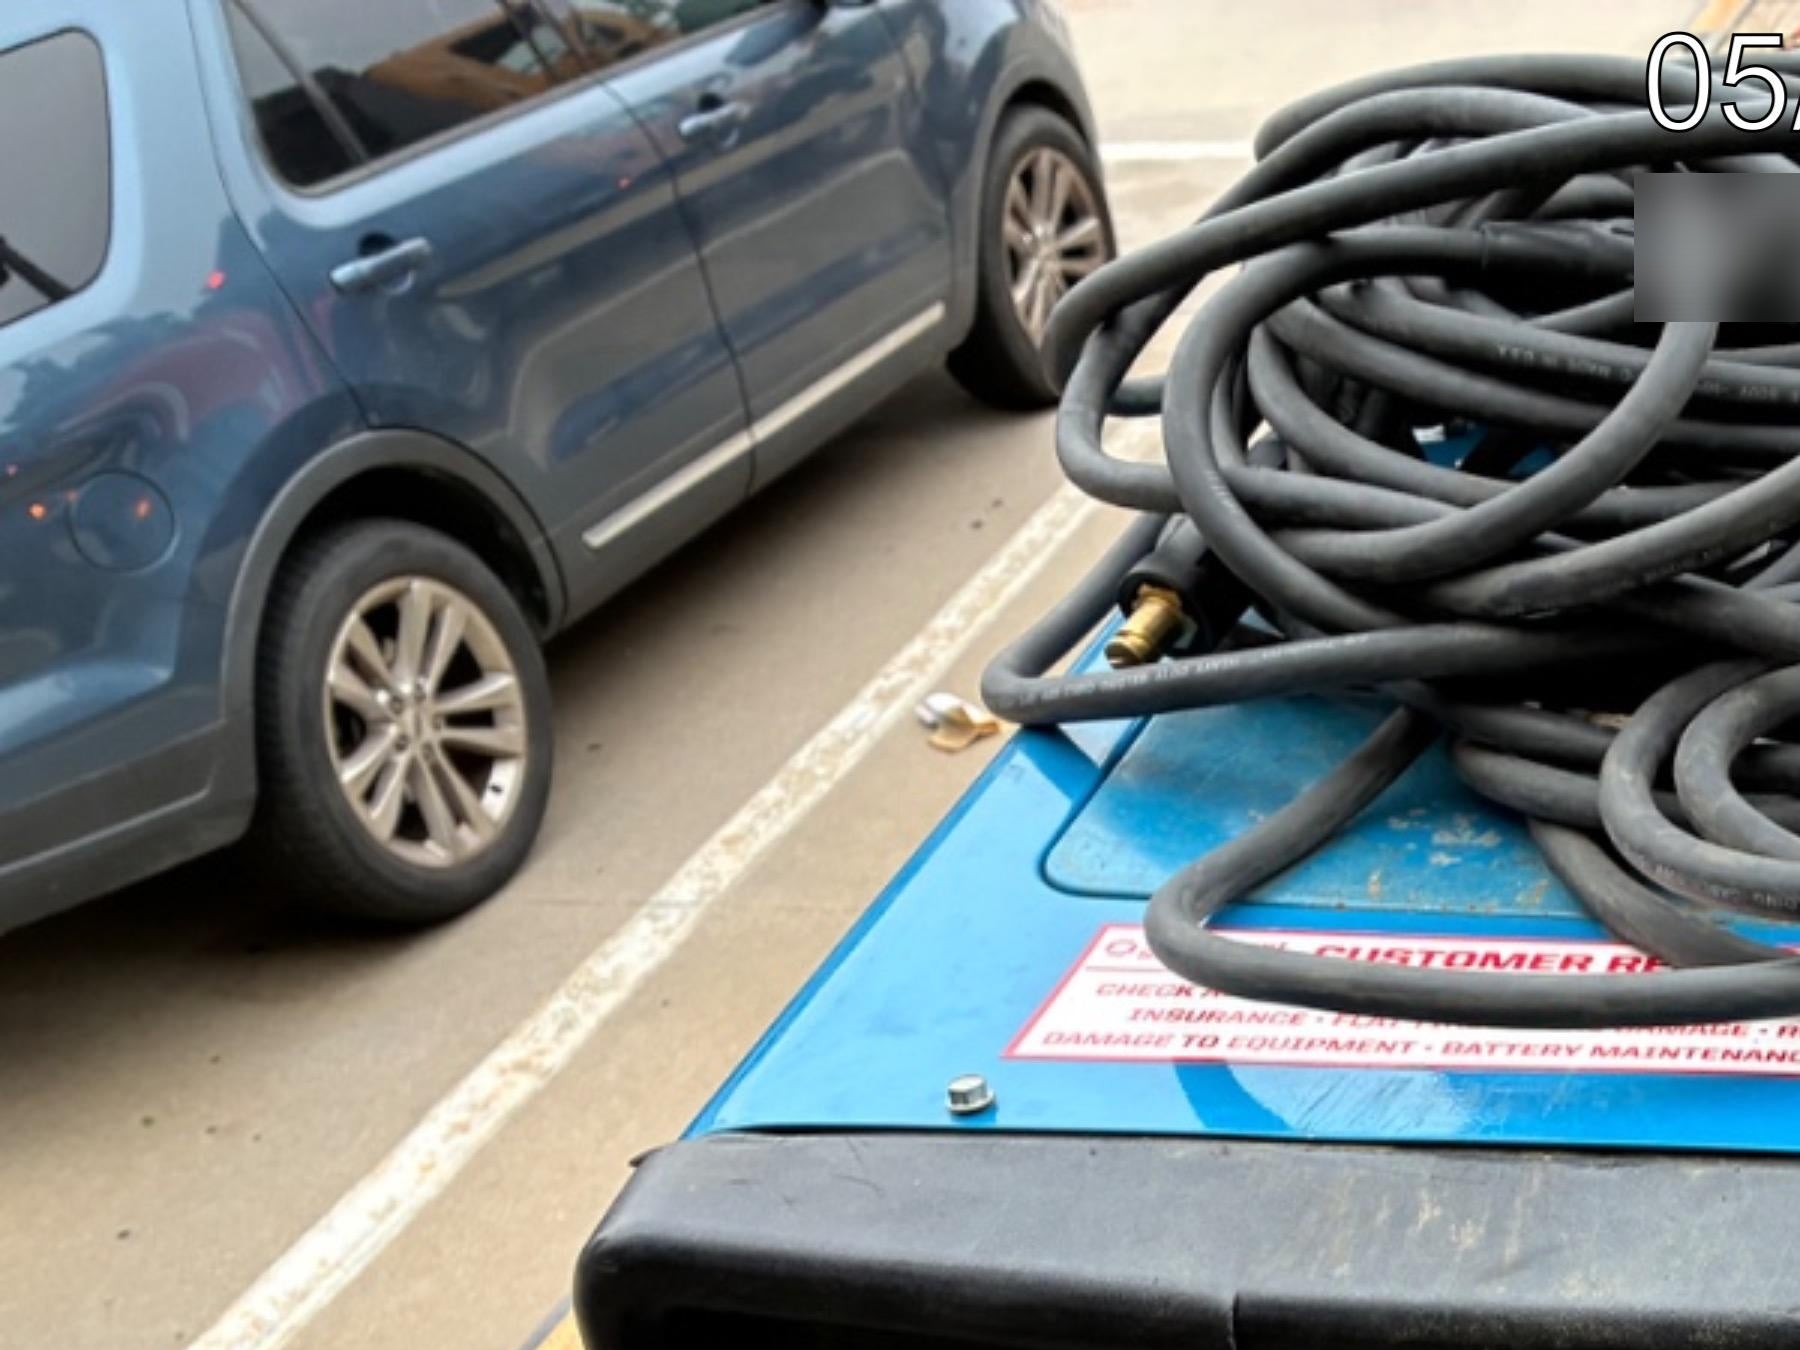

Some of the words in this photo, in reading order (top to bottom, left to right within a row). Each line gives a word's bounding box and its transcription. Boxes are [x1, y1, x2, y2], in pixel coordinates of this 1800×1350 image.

[1311, 943, 1594, 973] CUSTOMER
[1096, 982, 1193, 998] CHECK
[1128, 1007, 1304, 1026] INSURANCE
[1042, 1032, 1175, 1048] DAMAGE
[1183, 1034, 1221, 1049] TO
[1227, 1036, 1414, 1055] EQUIPMENT
[1442, 1042, 1583, 1058] BATTERY
